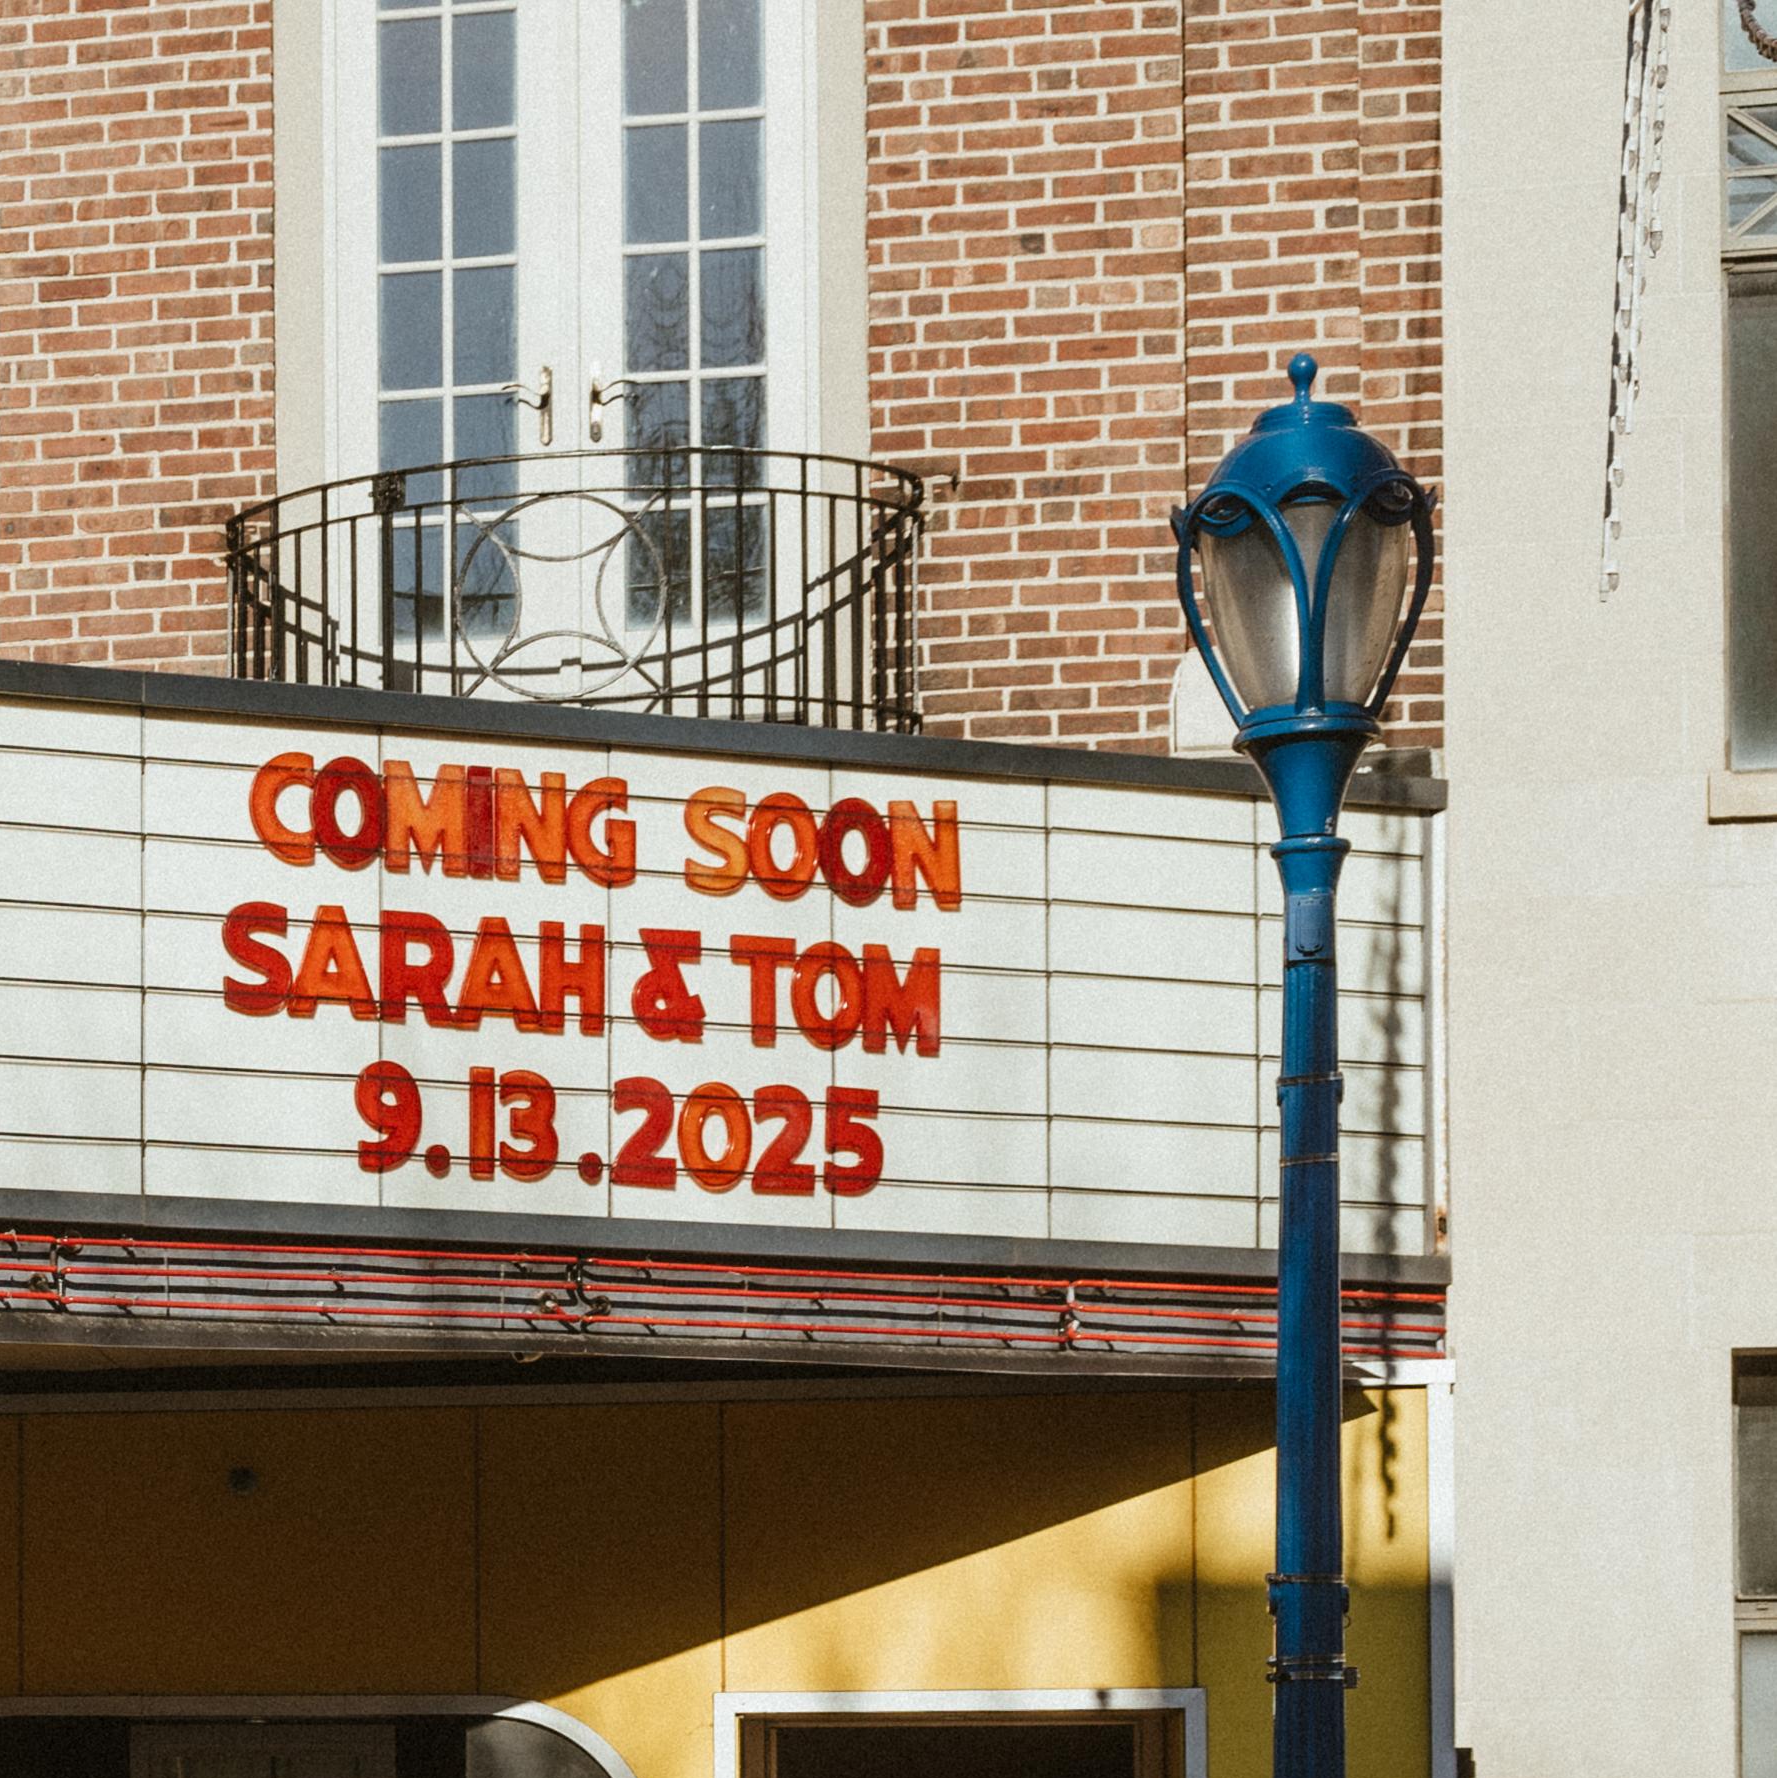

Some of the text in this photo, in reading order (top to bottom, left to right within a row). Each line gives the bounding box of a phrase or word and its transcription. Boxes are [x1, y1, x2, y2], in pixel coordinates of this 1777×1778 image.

[249, 750, 962, 911] COMING SOON
[221, 900, 942, 1057] SARAH & TOM
[353, 1059, 885, 1198] 9.13.2025
